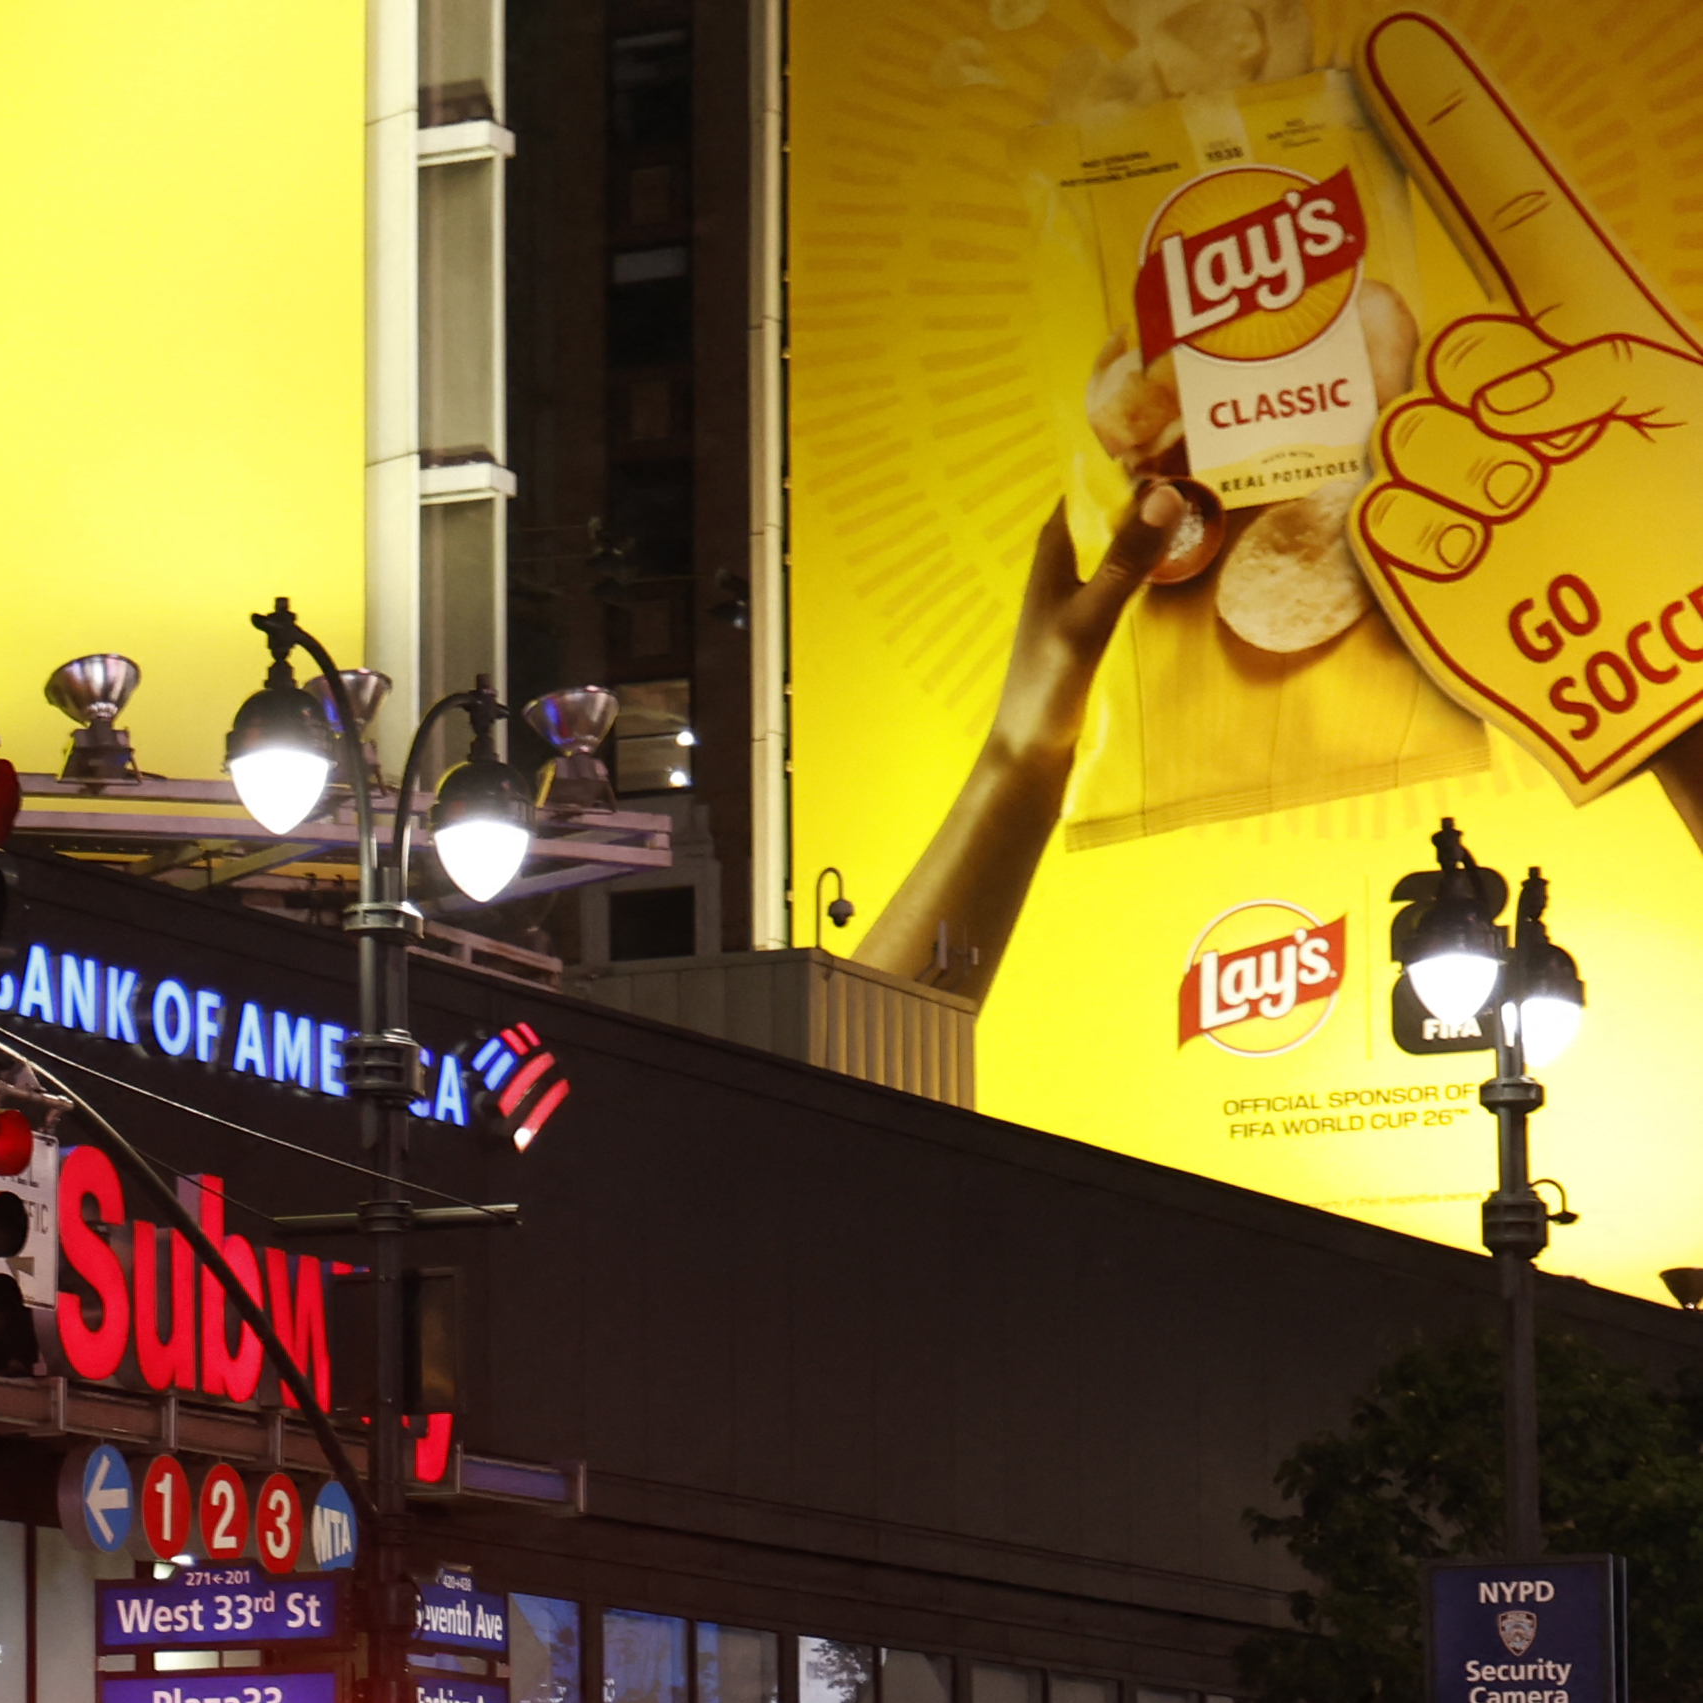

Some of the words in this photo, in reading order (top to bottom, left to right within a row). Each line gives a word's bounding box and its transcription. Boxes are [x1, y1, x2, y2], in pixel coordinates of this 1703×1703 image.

[1160, 190, 1349, 339] Lay's
[1209, 378, 1351, 428] CLASSIC
[1508, 574, 1601, 663] GO
[1199, 926, 1335, 1030] Lay's
[151, 977, 223, 1064] OF
[233, 1001, 471, 1126] AMEA
[1223, 1094, 1322, 1117] OFFICIAL
[1327, 1084, 1440, 1110] SPONSOR
[1445, 1083, 1475, 1101] OF
[1229, 1120, 1277, 1140] FIFA
[1282, 1115, 1365, 1137] WORLD
[1370, 1111, 1417, 1130] CUP
[155, 1471, 174, 1541] 1
[211, 1480, 238, 1550] 2
[266, 1489, 292, 1559] 3
[117, 1597, 204, 1634] West
[213, 1591, 276, 1631] 33rd
[286, 1592, 322, 1629] St
[1478, 1580, 1556, 1604] NYPD
[474, 1604, 503, 1641] Ave
[1465, 1658, 1572, 1686] Security
